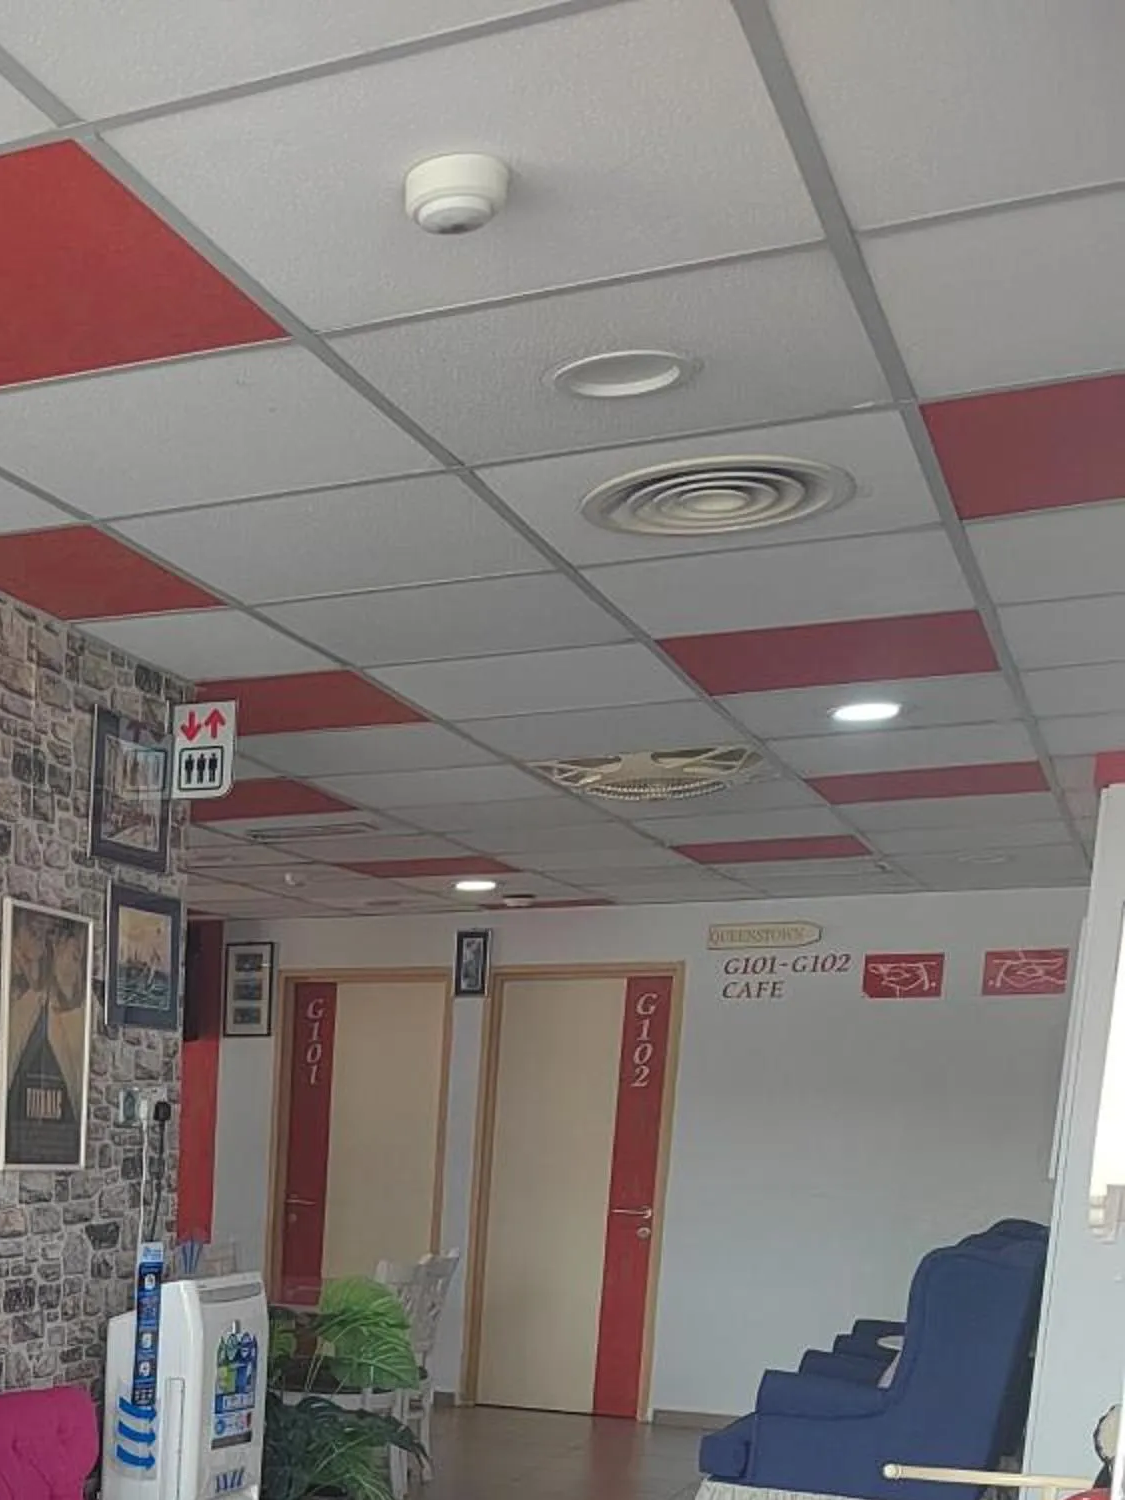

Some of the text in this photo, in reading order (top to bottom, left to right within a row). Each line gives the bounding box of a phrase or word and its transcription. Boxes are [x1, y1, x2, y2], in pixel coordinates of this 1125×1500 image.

[724, 953, 852, 975] G101-G102
[722, 980, 784, 999] CAFE
[630, 992, 659, 1087] G102
